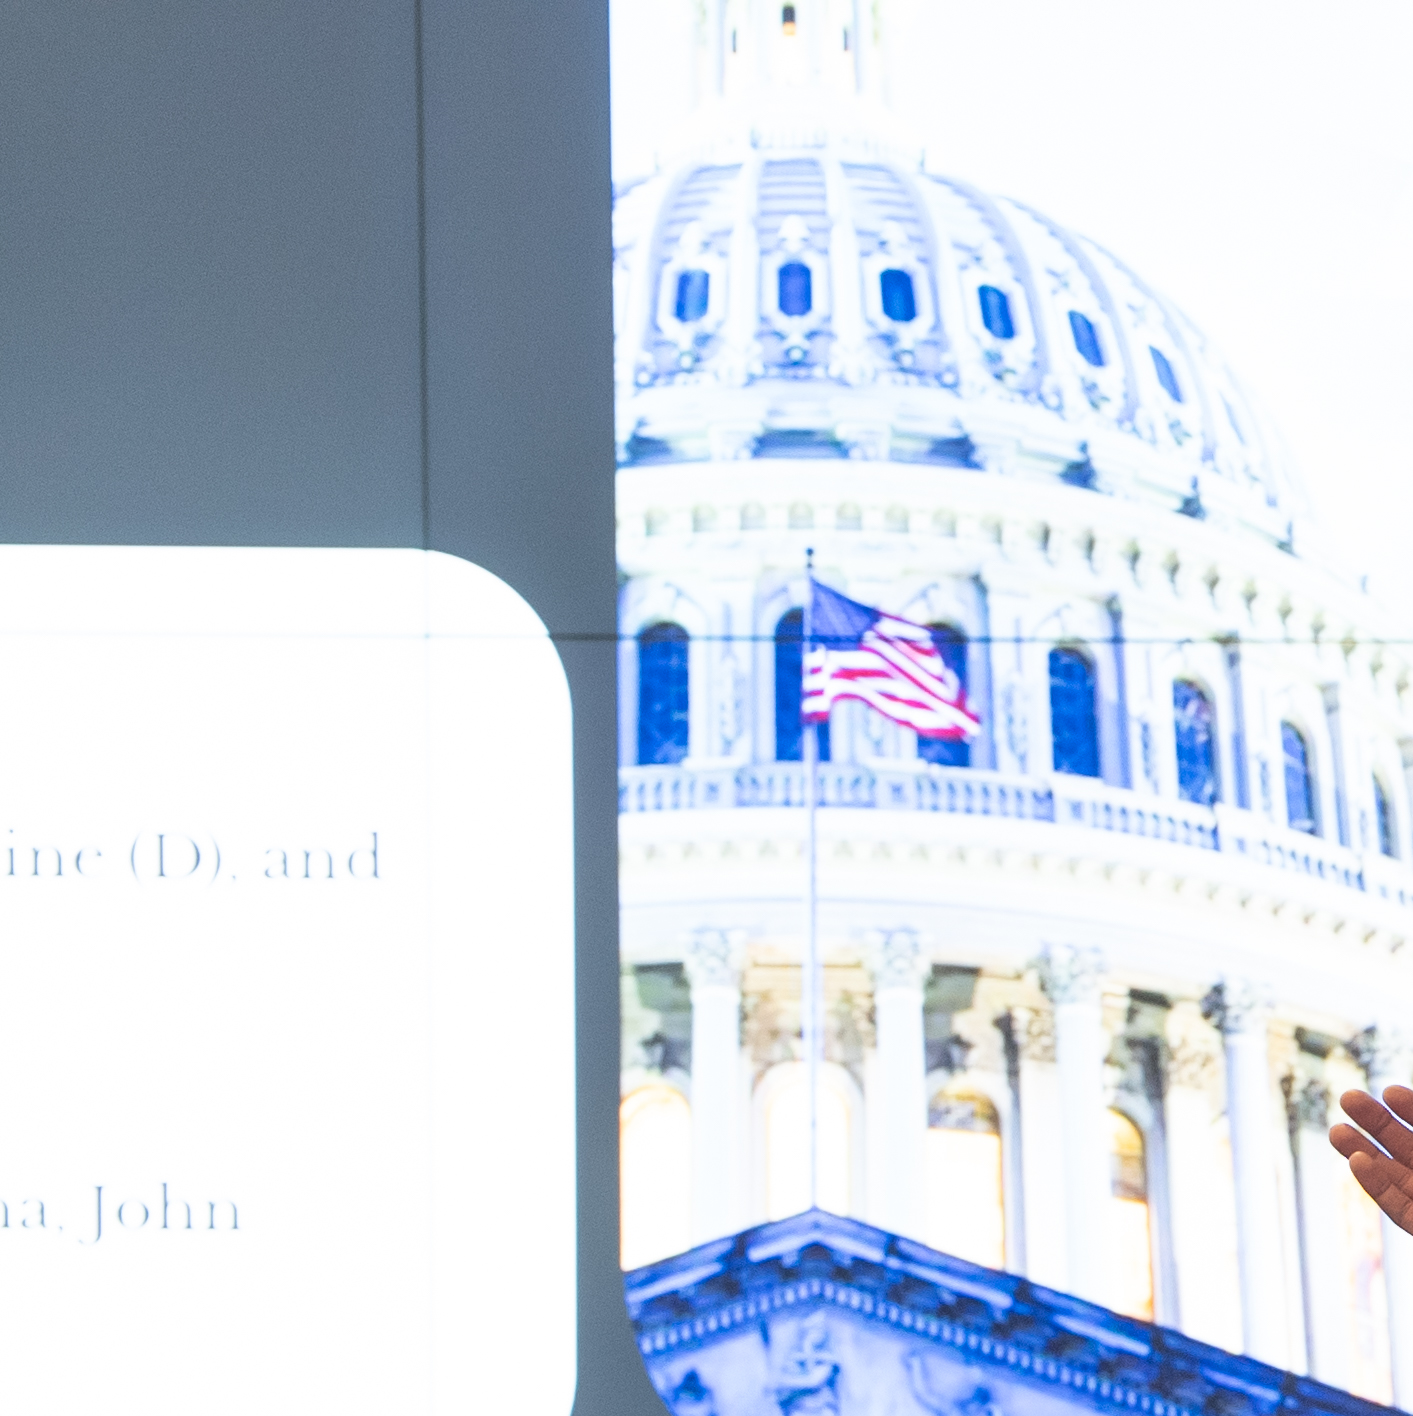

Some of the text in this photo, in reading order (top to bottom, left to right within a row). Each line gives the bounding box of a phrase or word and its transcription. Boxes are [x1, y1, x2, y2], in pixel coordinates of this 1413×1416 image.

[129, 830, 238, 885] (D),
[263, 830, 382, 880] and
[77, 1181, 242, 1246] John
